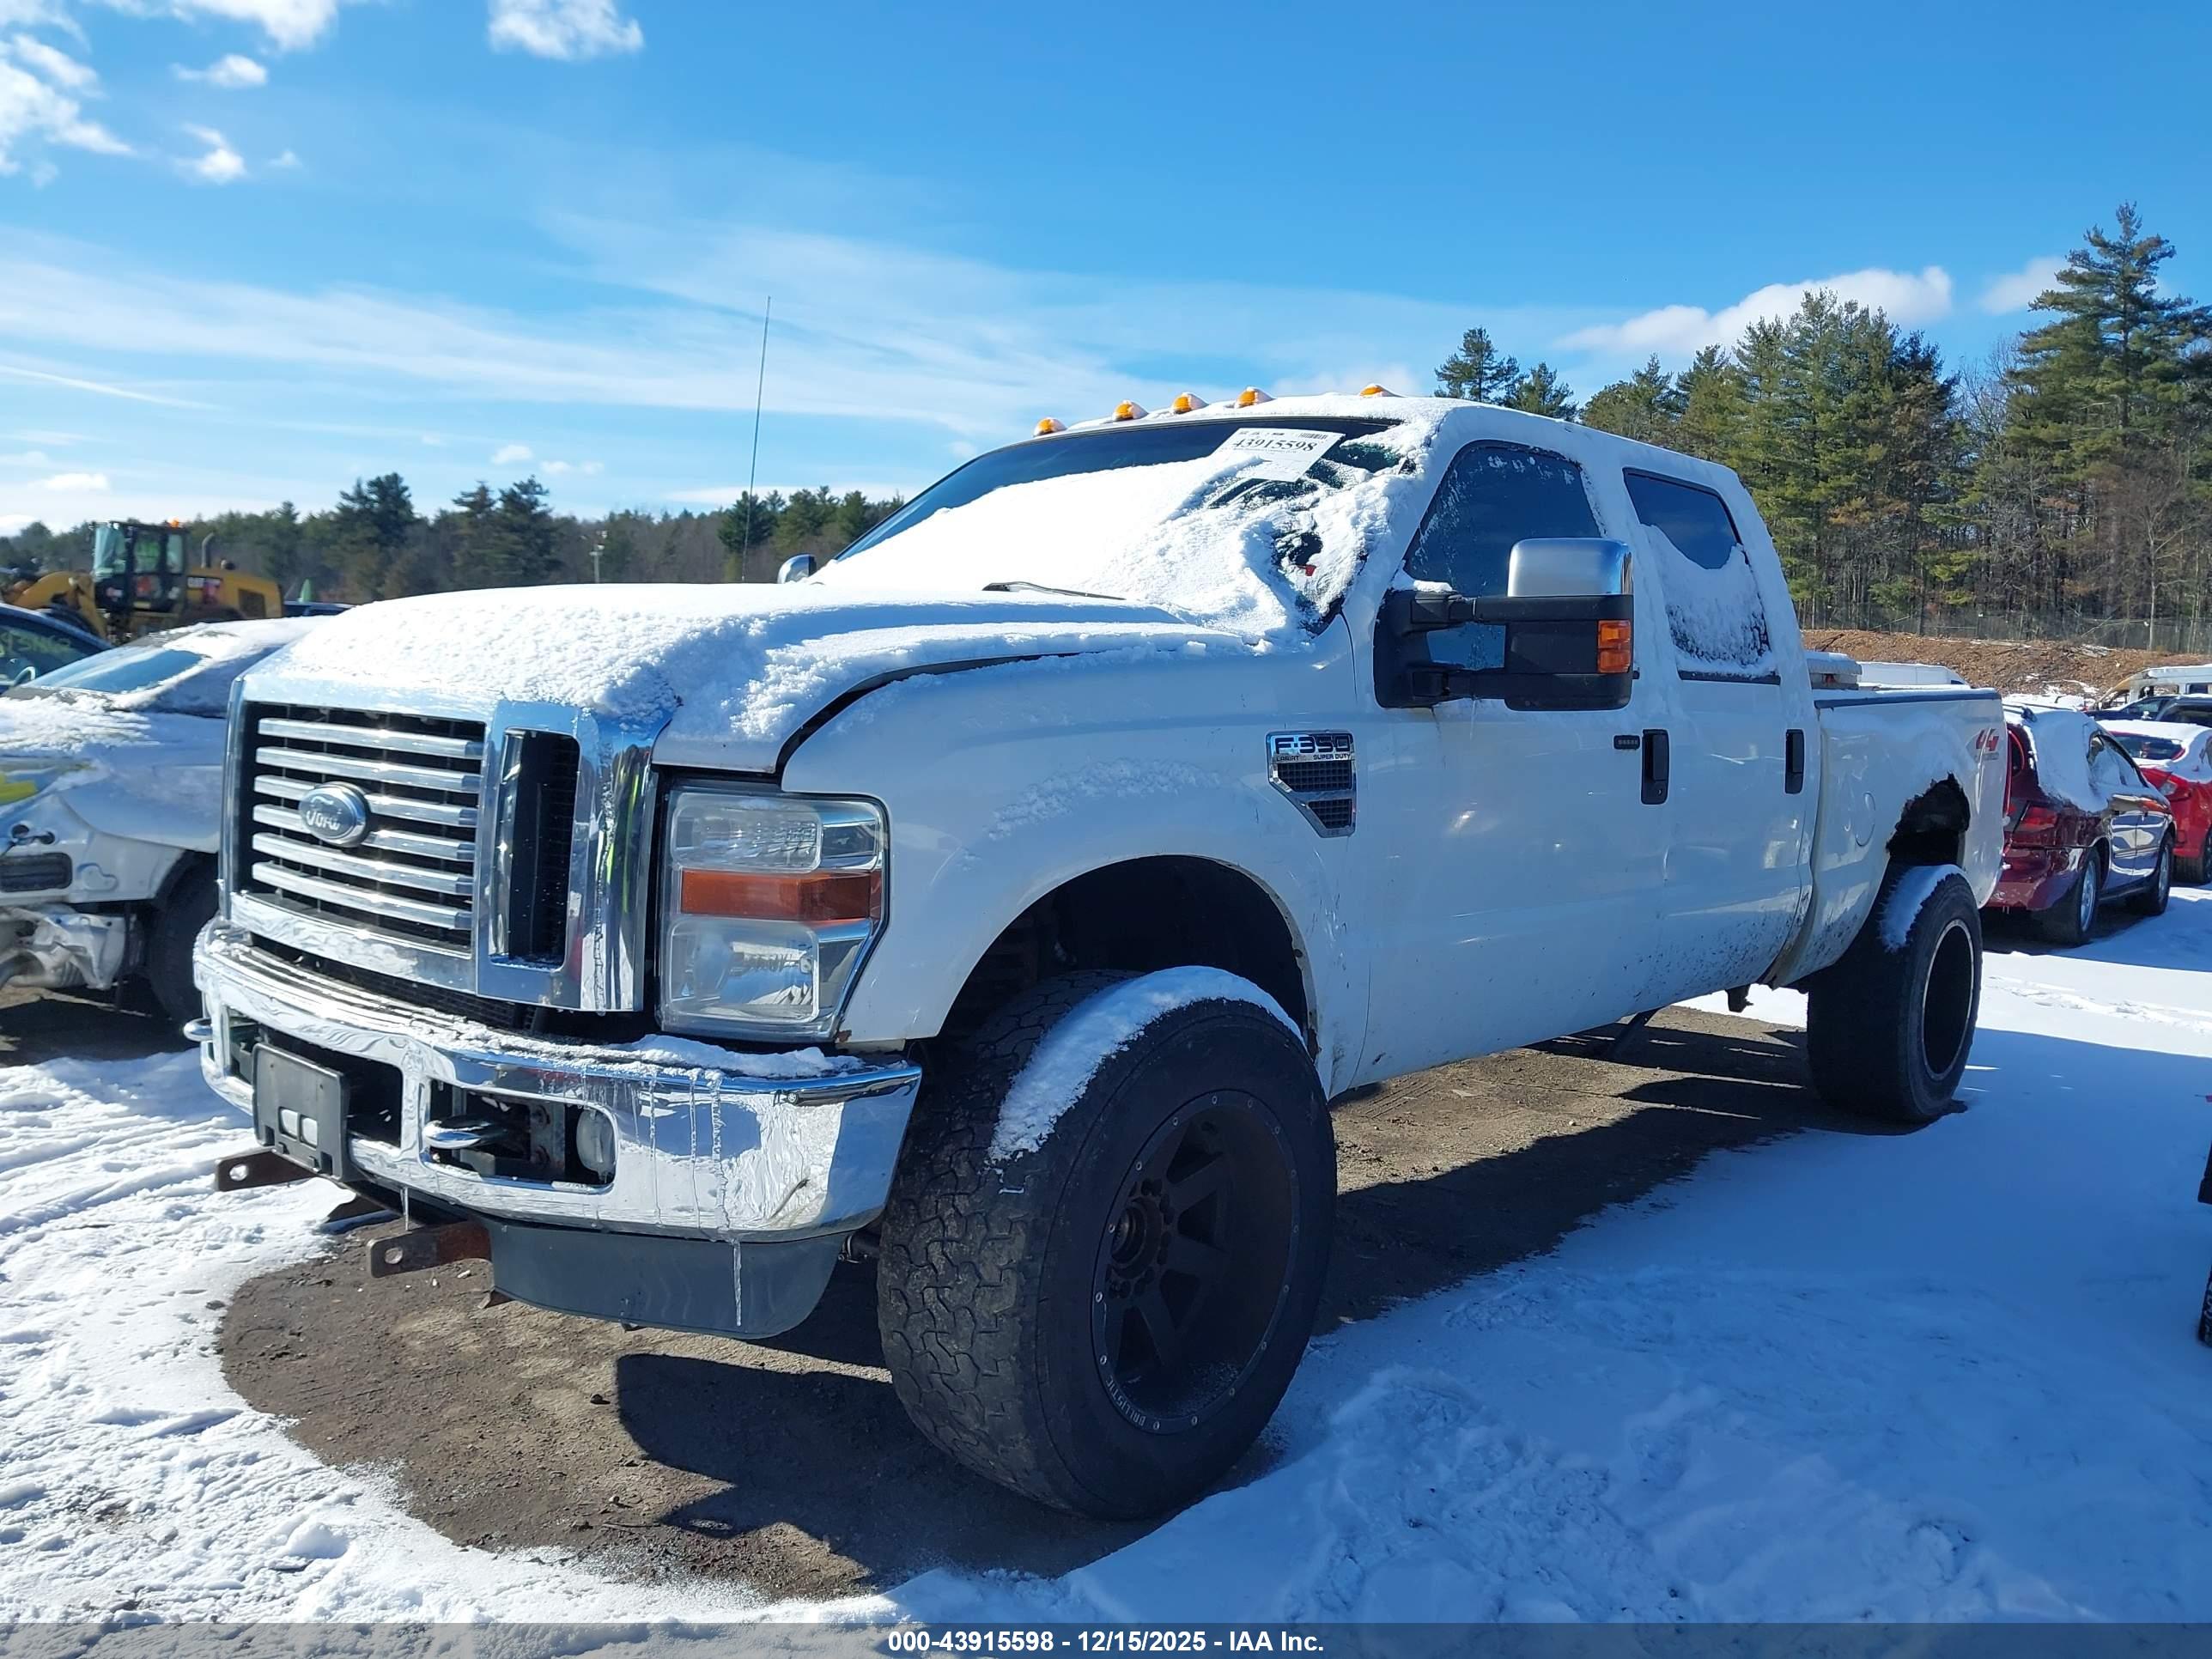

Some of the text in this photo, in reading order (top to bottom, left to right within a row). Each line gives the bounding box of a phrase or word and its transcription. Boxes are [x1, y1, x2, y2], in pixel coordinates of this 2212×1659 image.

[1233, 437, 1317, 452] 43915598
[1275, 735, 1351, 754] F-350
[305, 795, 341, 830] Ford
[1105, 1374, 1146, 1426] BALLISTIC
